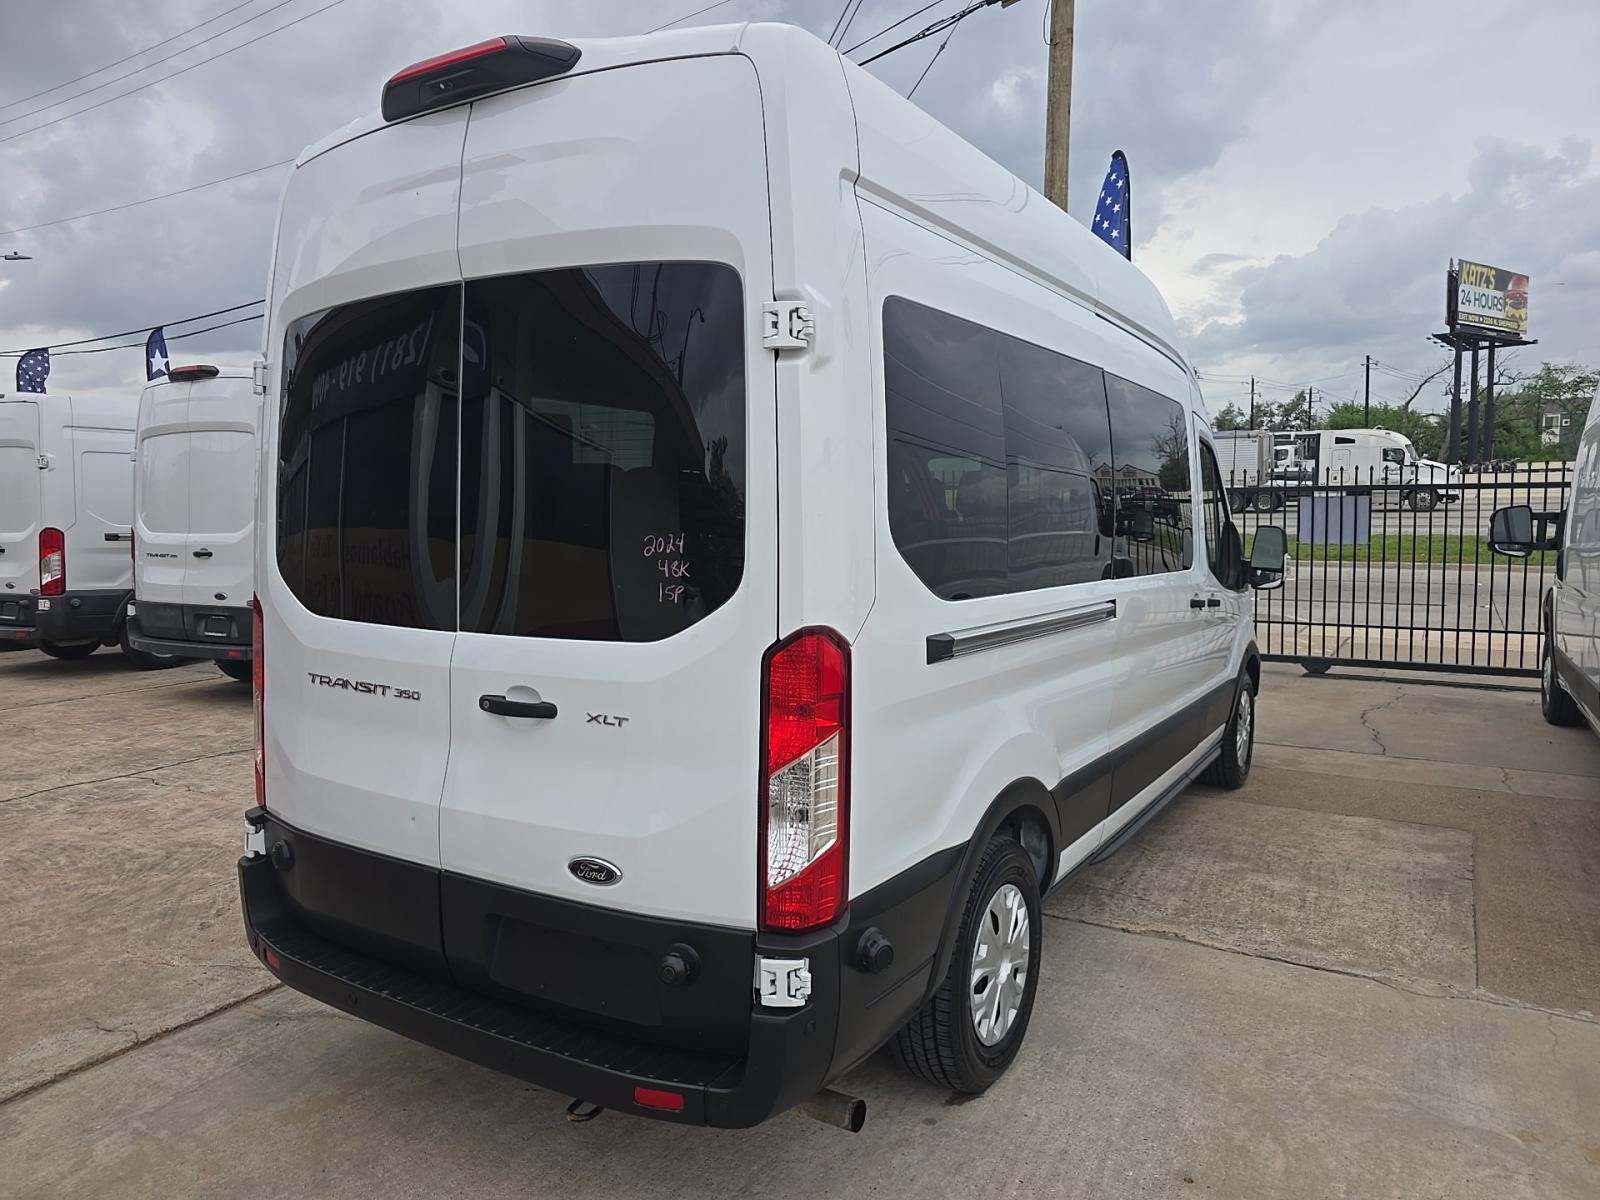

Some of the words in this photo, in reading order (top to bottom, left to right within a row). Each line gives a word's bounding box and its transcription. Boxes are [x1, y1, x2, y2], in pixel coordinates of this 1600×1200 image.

[1462, 263, 1496, 290] KATZ'S
[1461, 289, 1471, 306] 24
[1473, 291, 1503, 312] HOURS
[643, 533, 684, 556] 2024
[659, 560, 690, 577] 48K
[308, 672, 391, 696] TRANSIT
[394, 688, 421, 701] 350
[586, 712, 630, 727] XLT
[577, 863, 606, 881] Ford
